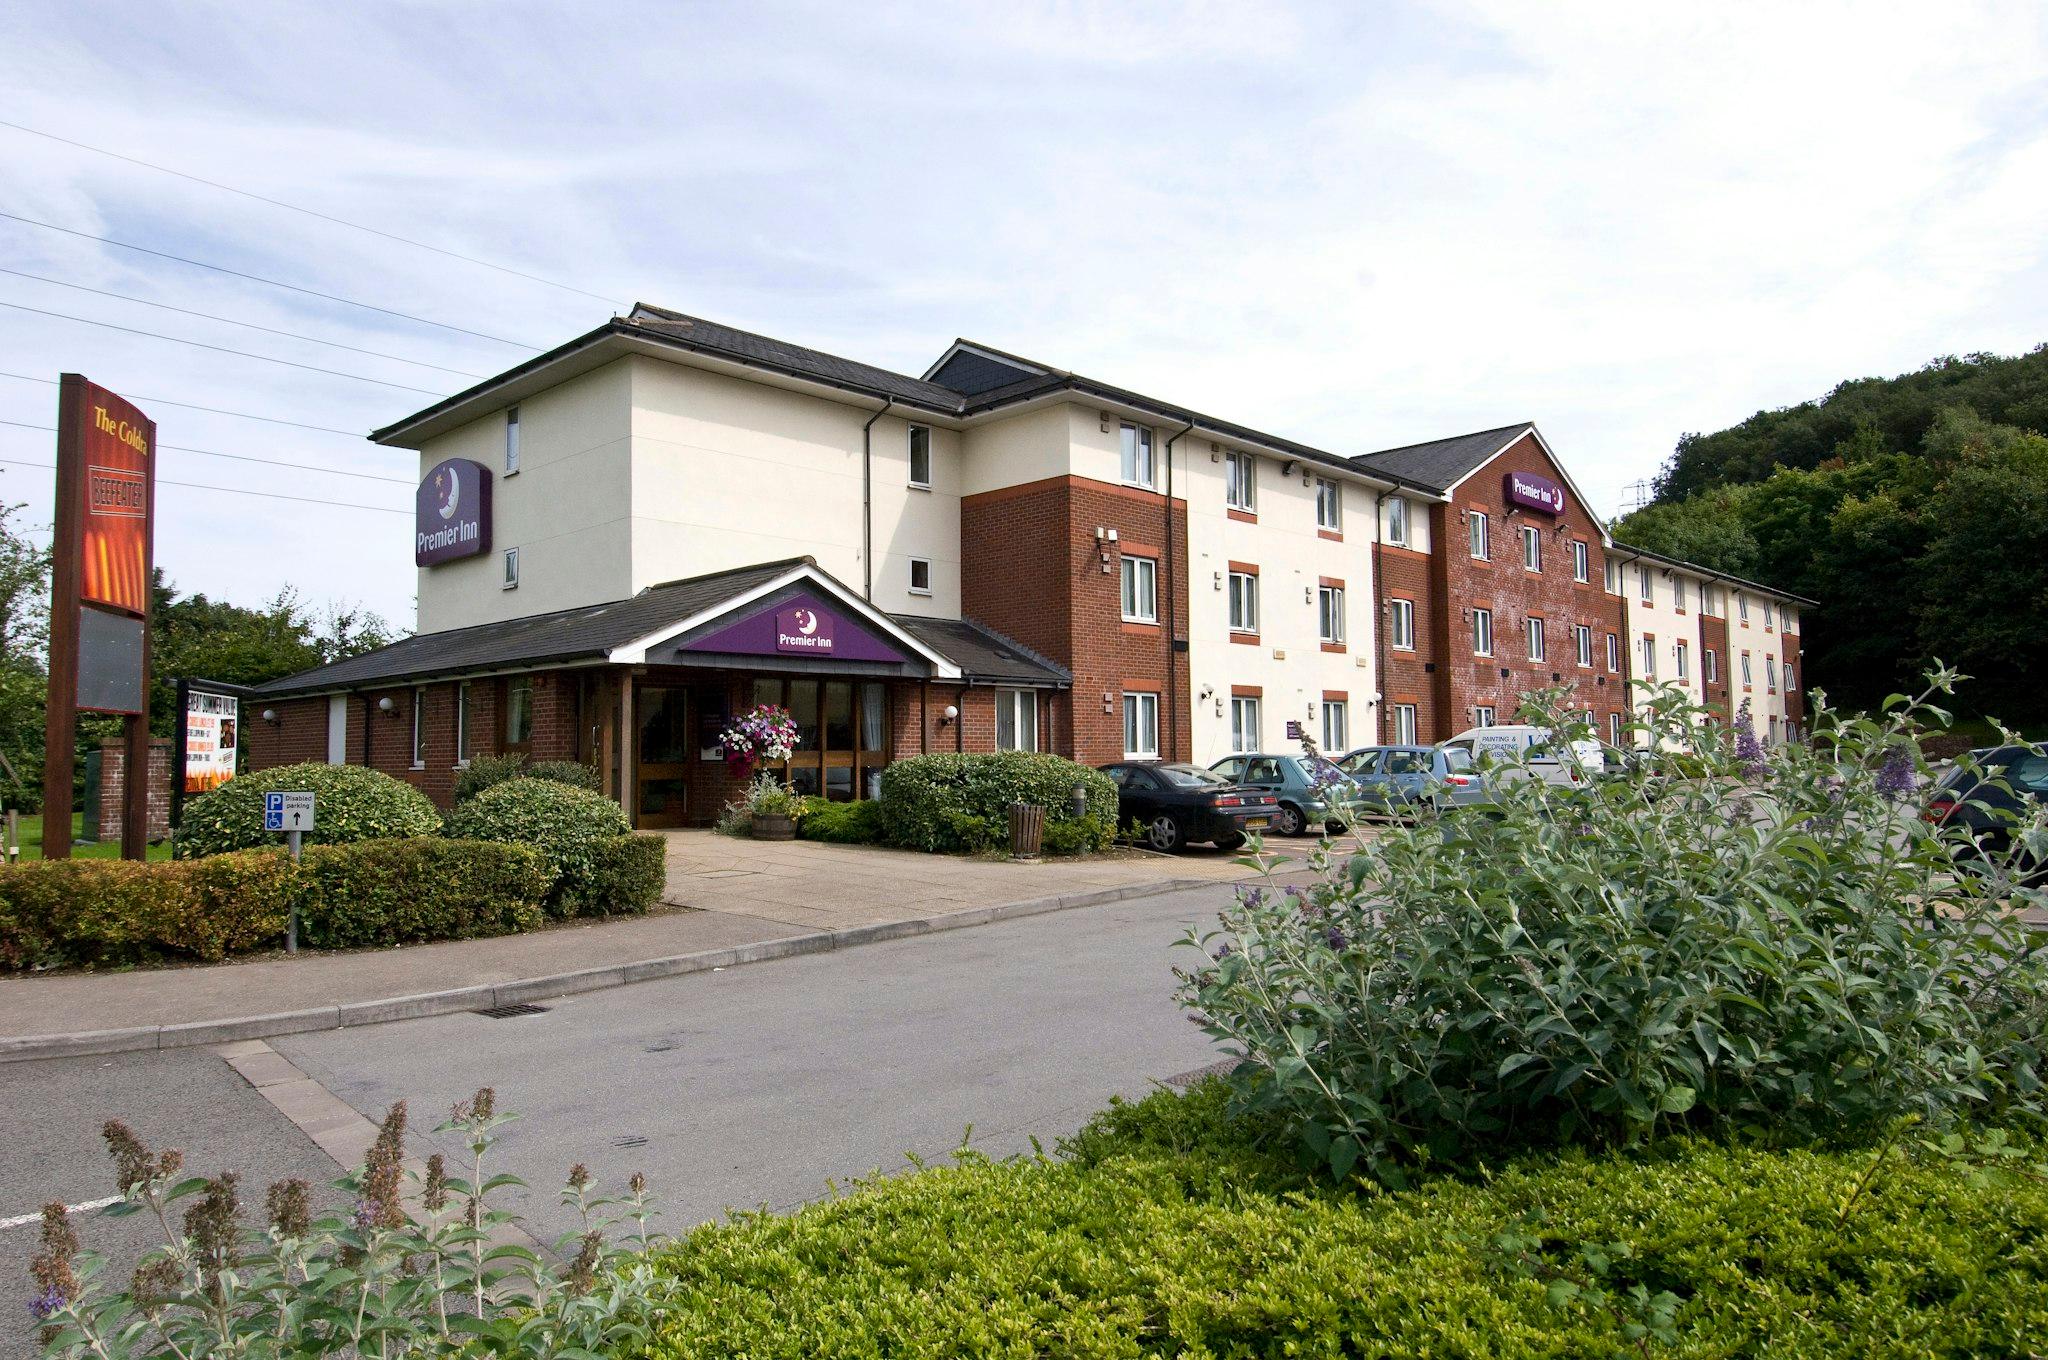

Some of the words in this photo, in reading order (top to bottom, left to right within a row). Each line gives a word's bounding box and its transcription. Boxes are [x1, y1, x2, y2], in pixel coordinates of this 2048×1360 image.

[95, 406, 116, 435] The
[119, 421, 147, 456] Coldra
[93, 476, 144, 509] BEEFEATER
[1514, 478, 1541, 500] Premier
[1541, 487, 1552, 504] Inn
[417, 524, 459, 554] Premier
[460, 519, 478, 541] Inn
[779, 633, 817, 647] Premier
[817, 636, 832, 648] Inn
[202, 694, 222, 714] SUMMER
[1478, 743, 1518, 751] DECORATING
[270, 794, 282, 810] P
